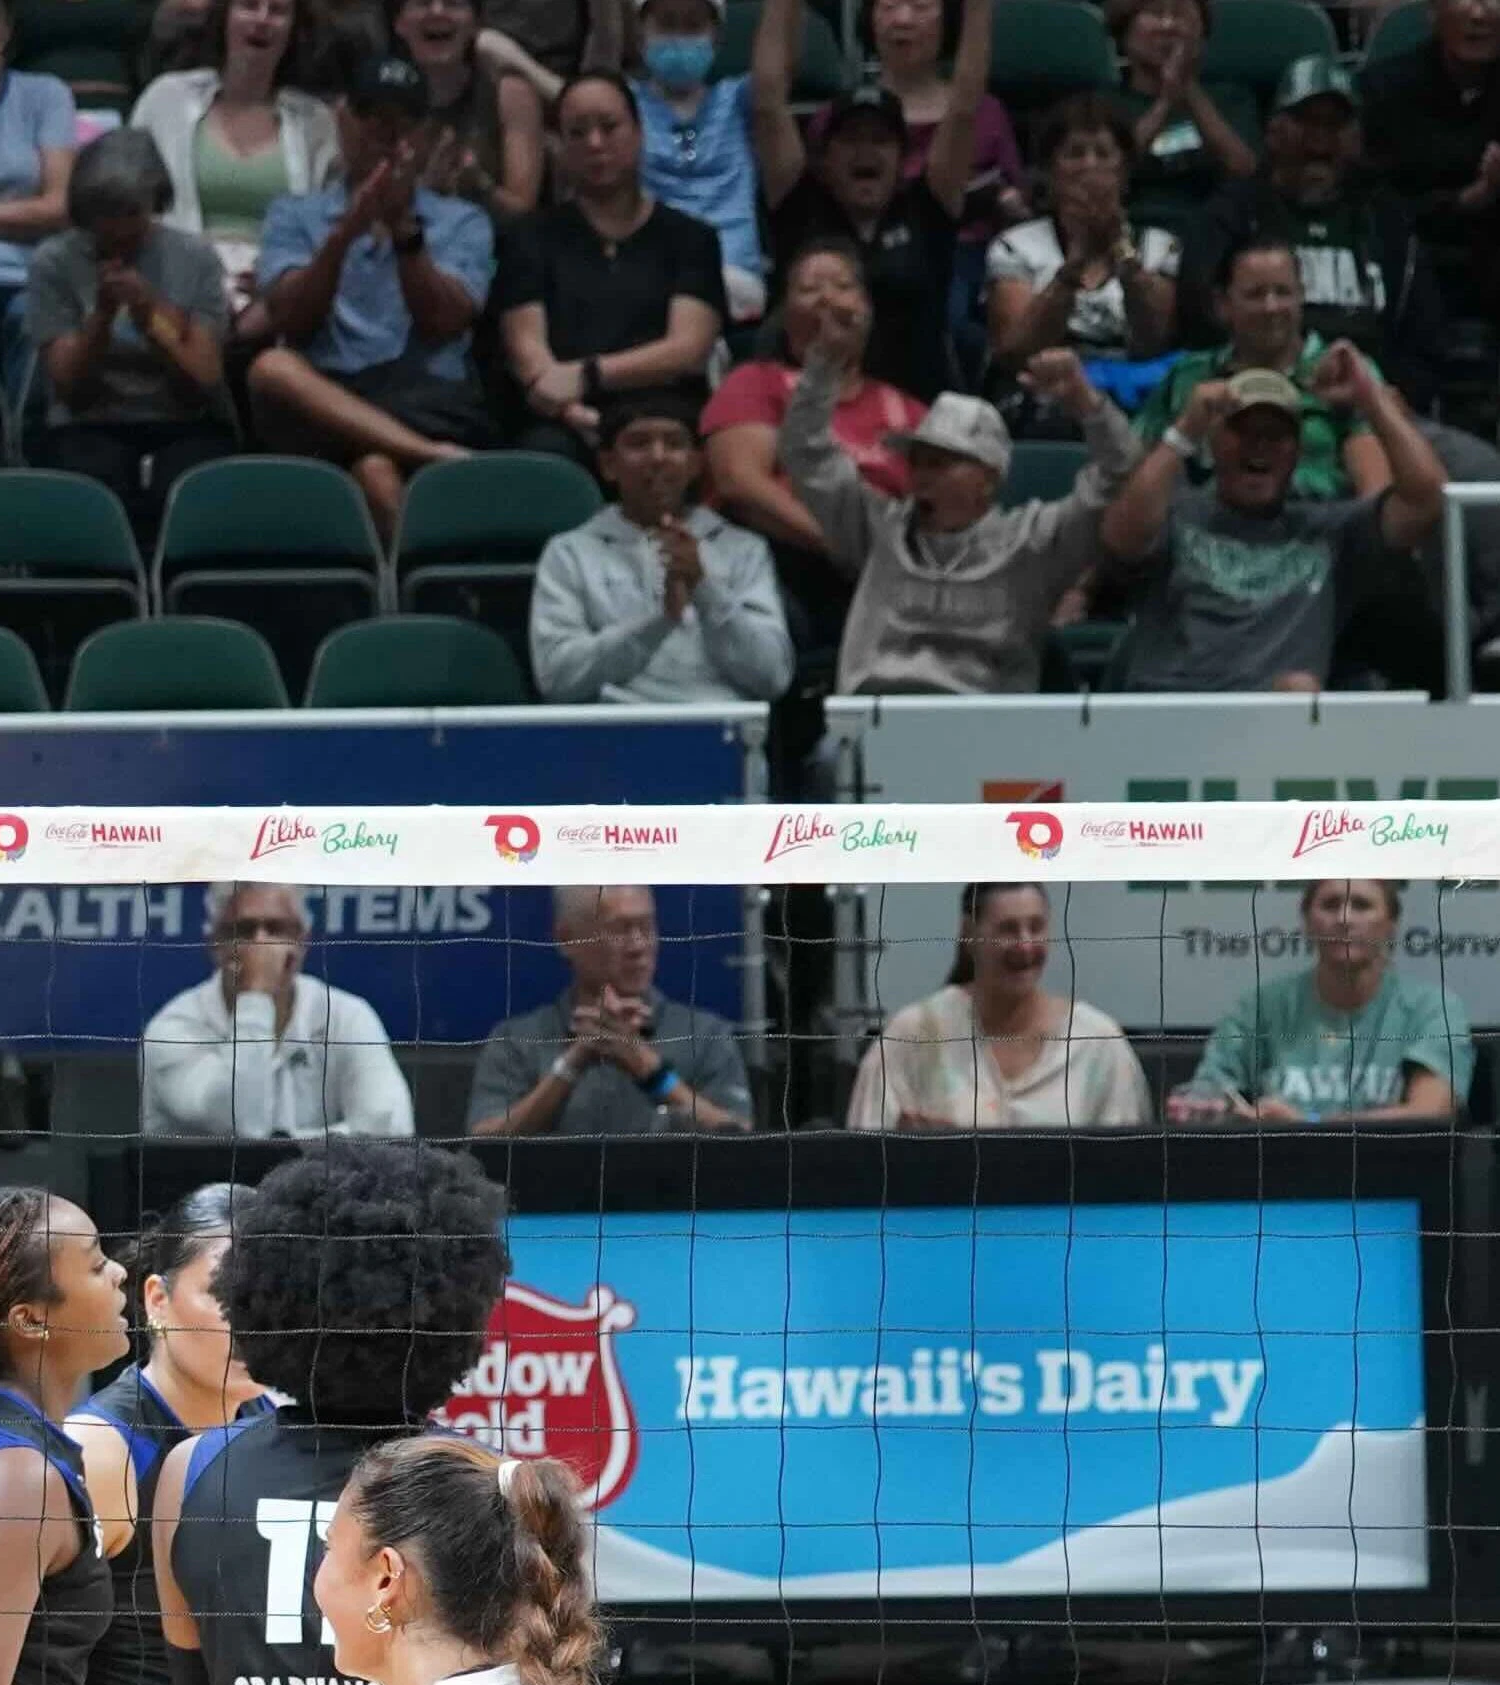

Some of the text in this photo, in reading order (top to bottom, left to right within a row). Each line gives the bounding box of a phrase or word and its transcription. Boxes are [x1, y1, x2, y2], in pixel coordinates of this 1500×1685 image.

[91, 822, 162, 842] HAWAII
[249, 815, 399, 861] Liliha Bakery
[605, 824, 678, 844] HAWAII
[764, 813, 918, 863] Liliha Bakery
[1129, 820, 1204, 840] HAWAII
[1292, 809, 1449, 858] Liliha Bakery
[675, 1344, 1265, 1428] Hawaii's Dairy
